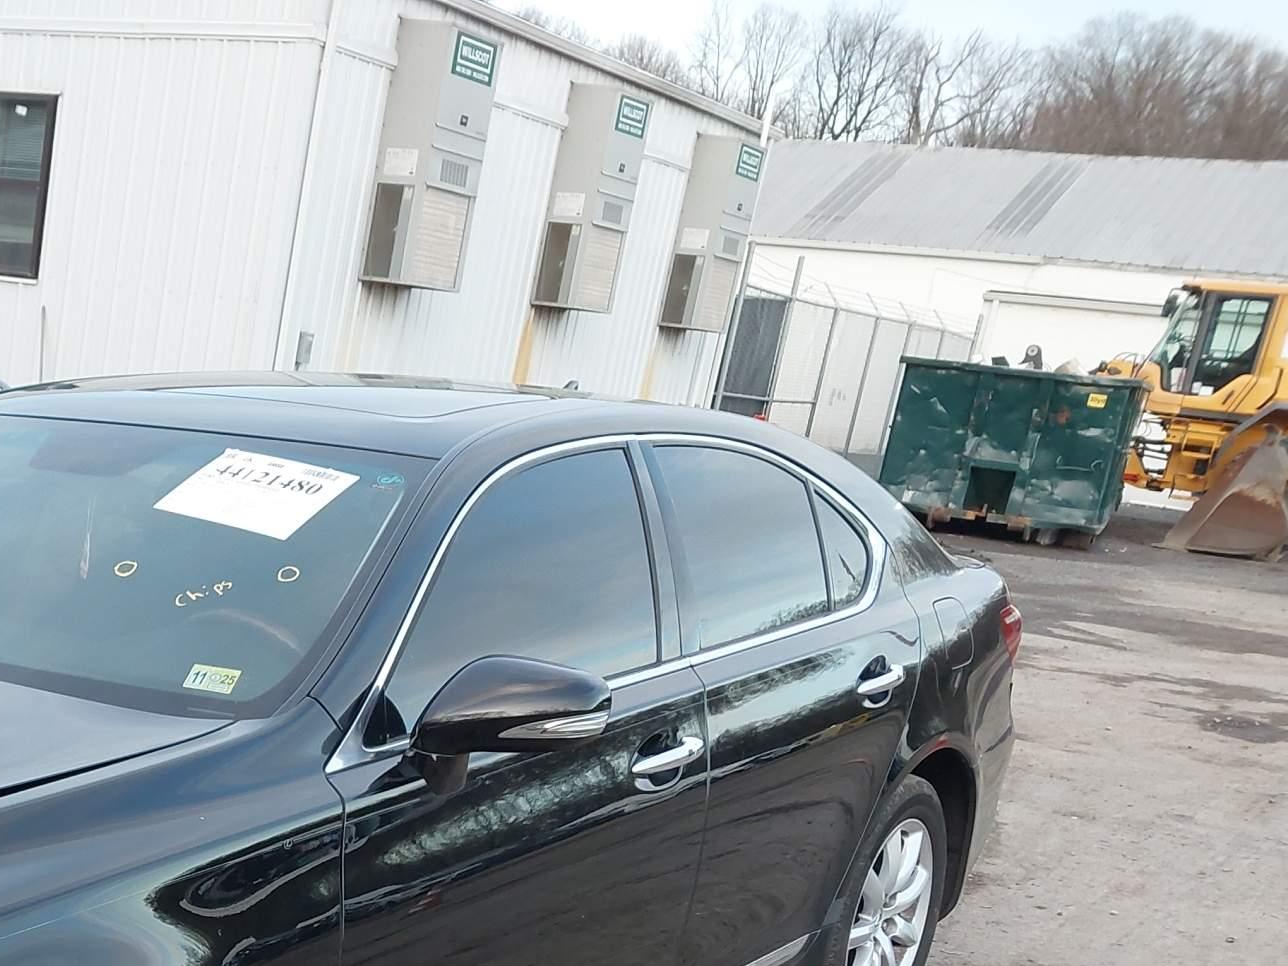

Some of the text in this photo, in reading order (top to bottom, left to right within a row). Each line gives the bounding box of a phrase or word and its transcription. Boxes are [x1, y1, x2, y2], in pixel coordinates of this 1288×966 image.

[462, 45, 489, 65] WILLSCOT
[216, 463, 324, 497] 44121480
[191, 670, 237, 686] 11 25
